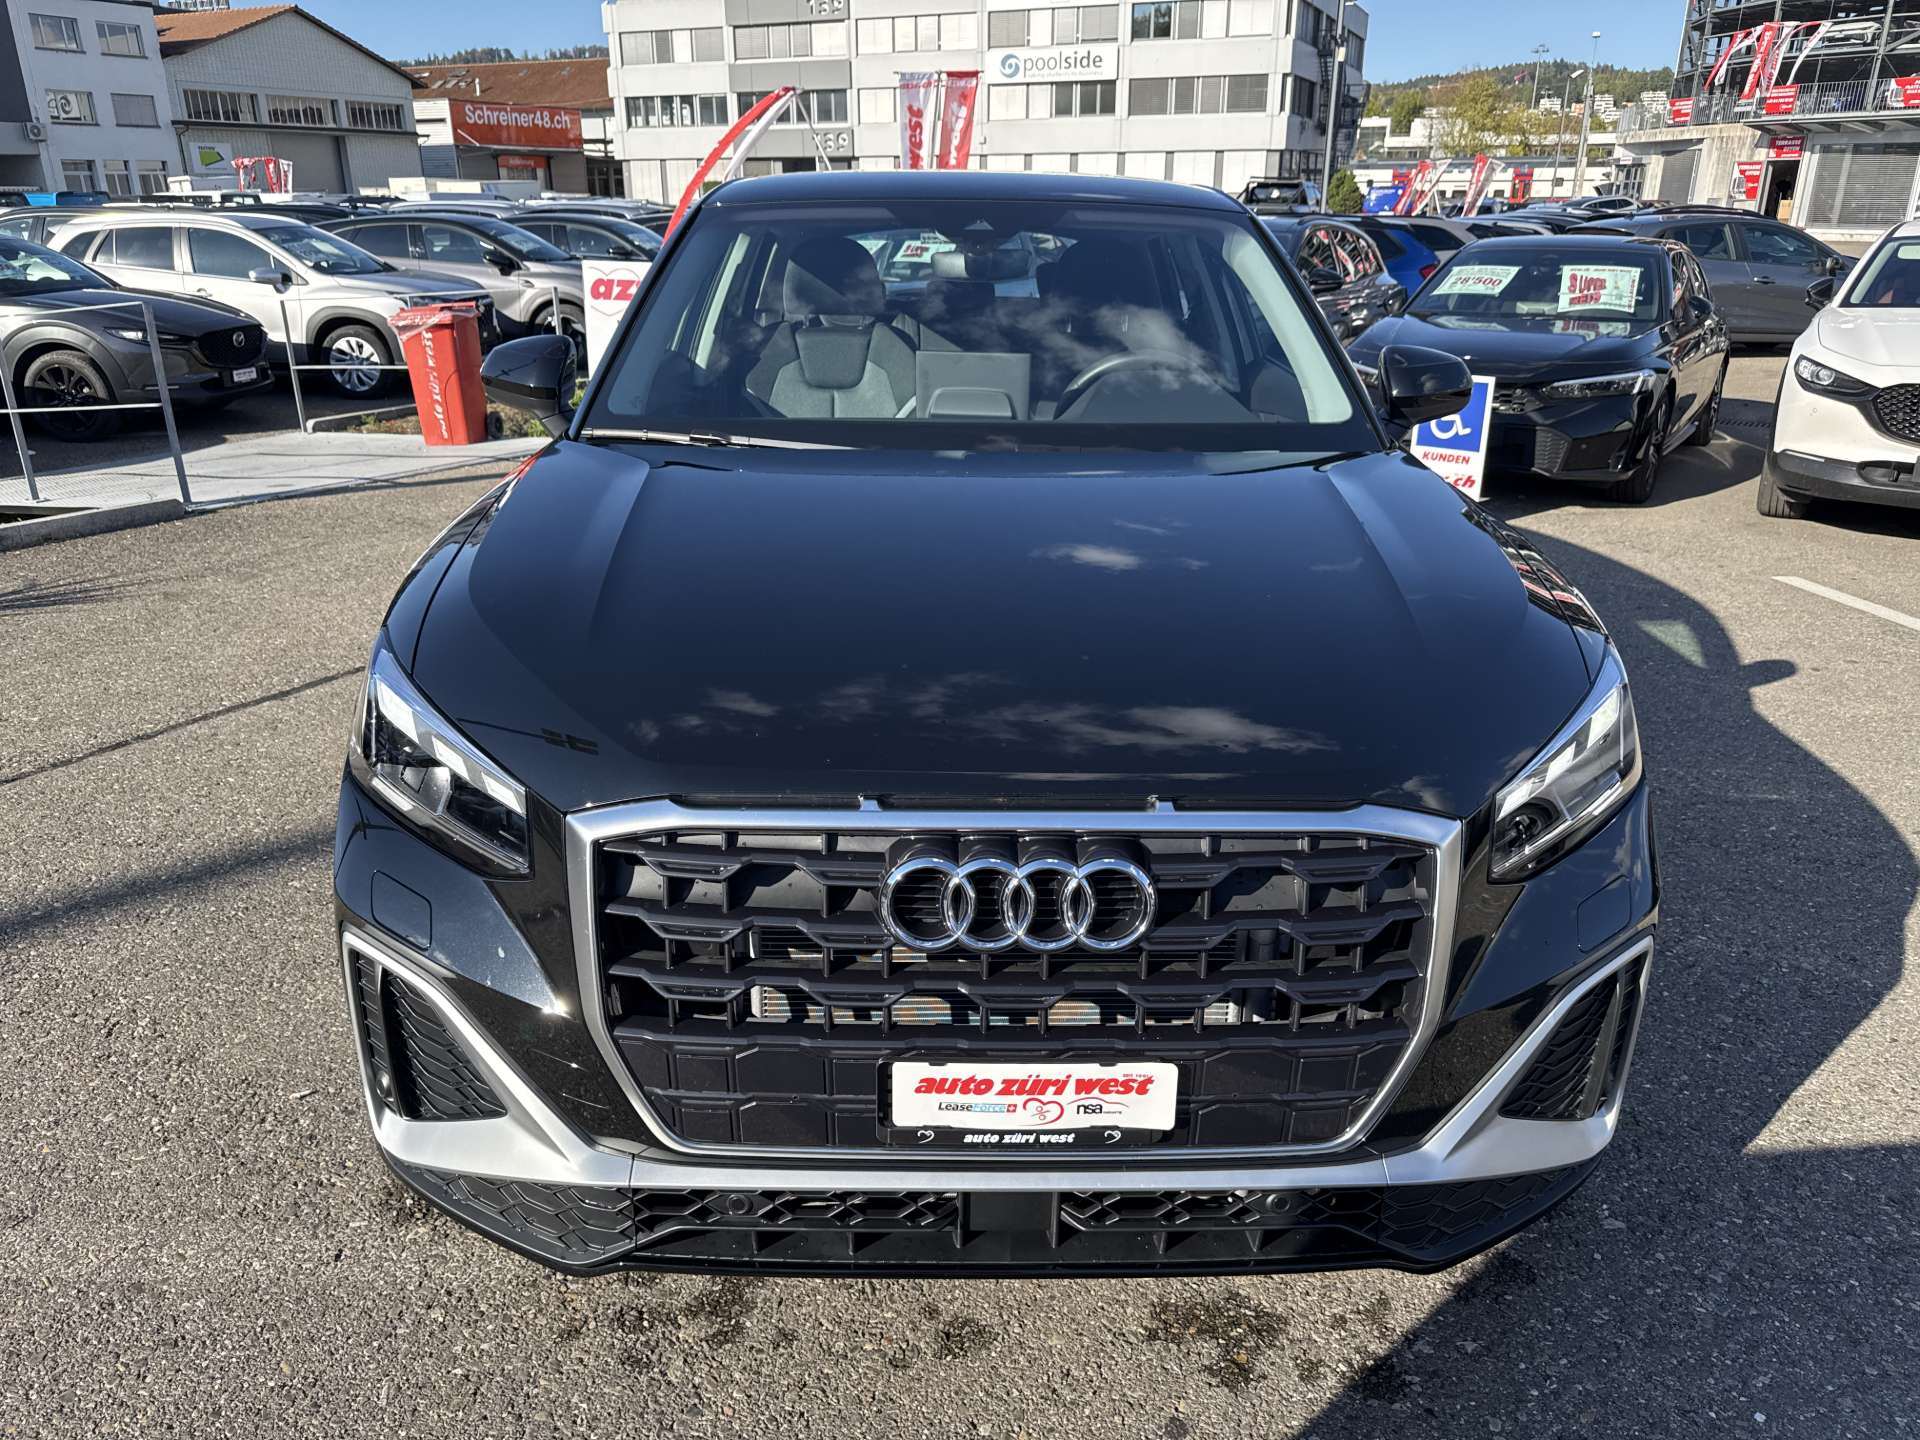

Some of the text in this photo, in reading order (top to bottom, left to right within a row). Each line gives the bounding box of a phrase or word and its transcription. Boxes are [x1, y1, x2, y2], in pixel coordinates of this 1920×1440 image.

[1023, 50, 1102, 78] poolside
[464, 104, 571, 129] Schreiner48.ch
[813, 132, 849, 151] 139
[907, 103, 923, 169] west
[1453, 276, 1503, 287] 28'500
[434, 403, 448, 439] auto
[1422, 451, 1470, 465] KUNDEN
[914, 1074, 1155, 1095] auto züri west
[938, 1102, 1006, 1113] LeaseForce
[1077, 1103, 1103, 1115] nsa
[963, 1132, 1076, 1143] auto züri west
